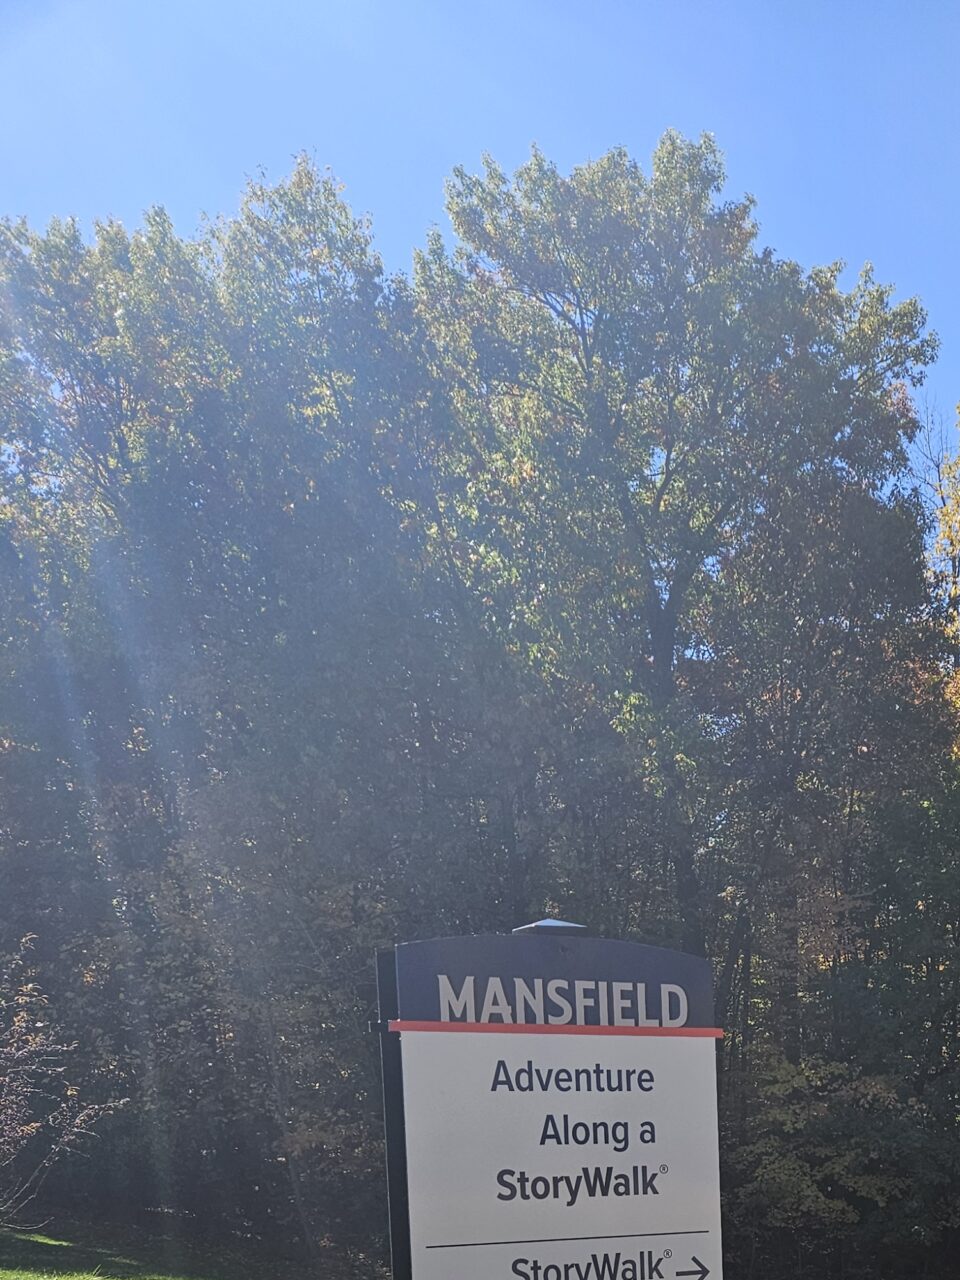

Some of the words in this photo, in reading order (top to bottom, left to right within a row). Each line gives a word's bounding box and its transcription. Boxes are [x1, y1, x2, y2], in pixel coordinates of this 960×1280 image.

[437, 974, 688, 1028] MANSFIELD
[490, 1060, 655, 1092] Adventure
[539, 1114, 629, 1152] Along
[639, 1120, 656, 1144] a
